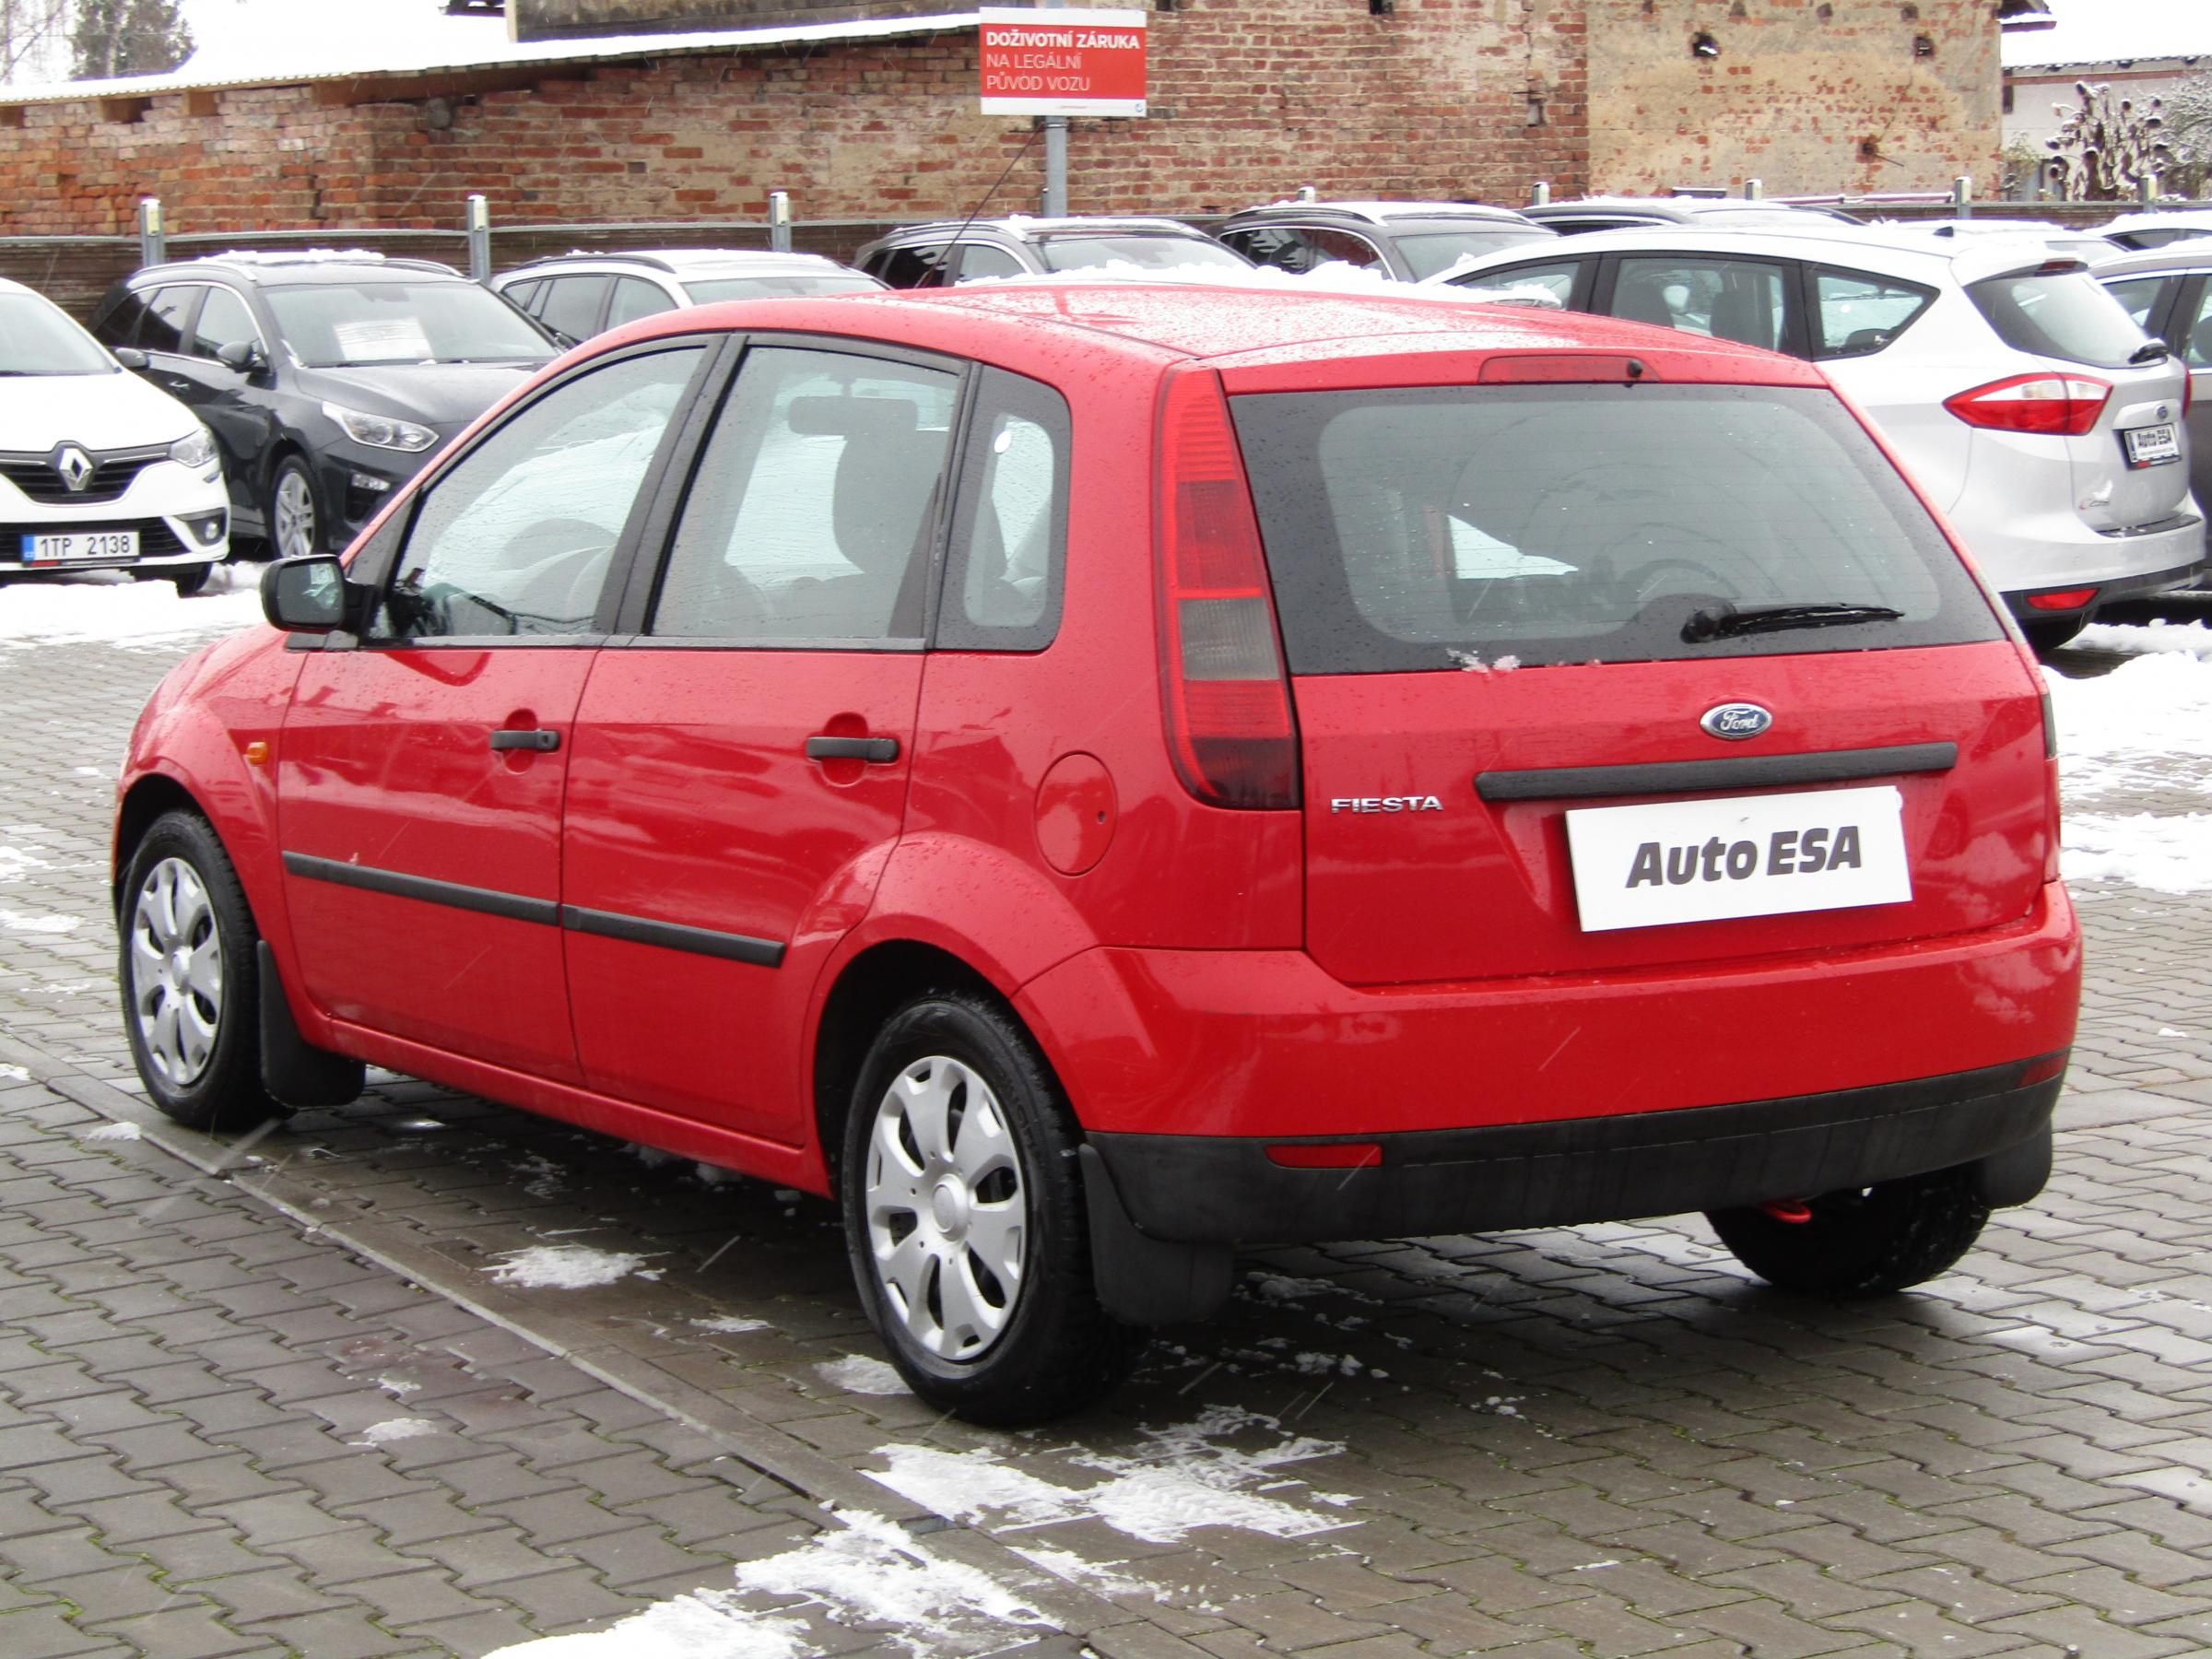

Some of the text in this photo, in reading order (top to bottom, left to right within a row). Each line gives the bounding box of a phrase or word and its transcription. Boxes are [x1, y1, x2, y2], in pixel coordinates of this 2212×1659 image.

[986, 29, 1140, 49] DOŽIVOTNÍ ZÁRUKA
[986, 52, 1082, 70] NA LEGÁLNÍ
[986, 72, 1090, 91] PŮVOD VOZU
[40, 535, 130, 557] 1TP 2138
[1720, 710, 1759, 731] Ford
[1331, 795, 1443, 813] FIESTA
[1625, 826, 1861, 888] Auto ESA
